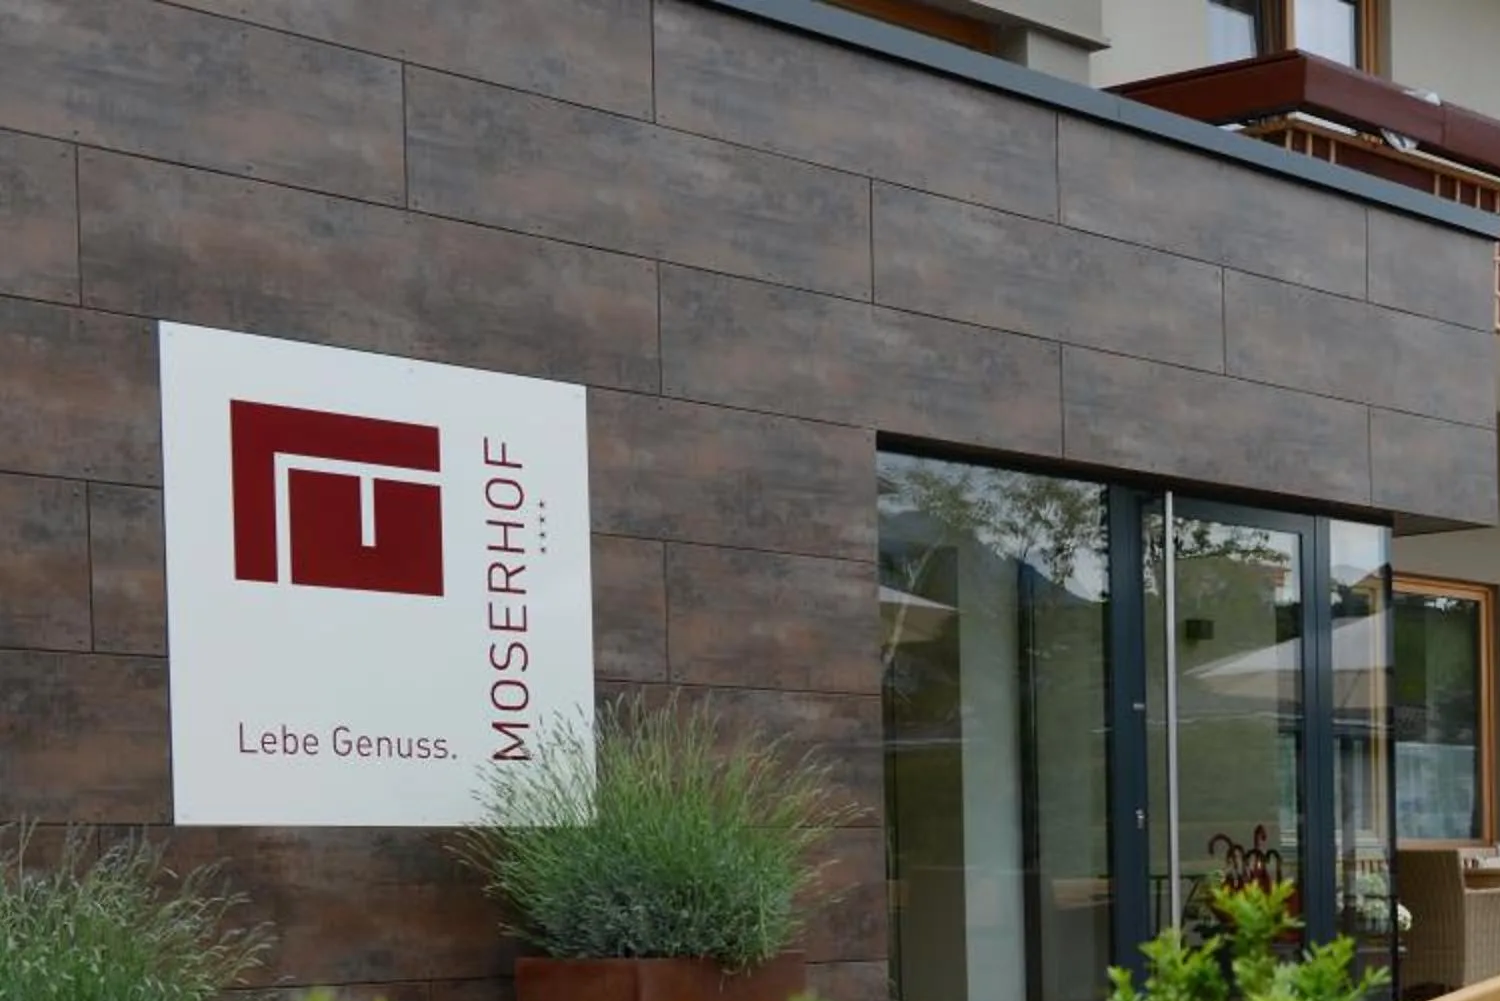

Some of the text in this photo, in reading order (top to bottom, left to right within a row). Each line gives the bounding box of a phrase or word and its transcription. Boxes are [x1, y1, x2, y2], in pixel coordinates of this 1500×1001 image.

[483, 436, 531, 761] MOSERHOF
[239, 722, 457, 760] Lebe Genuss.
